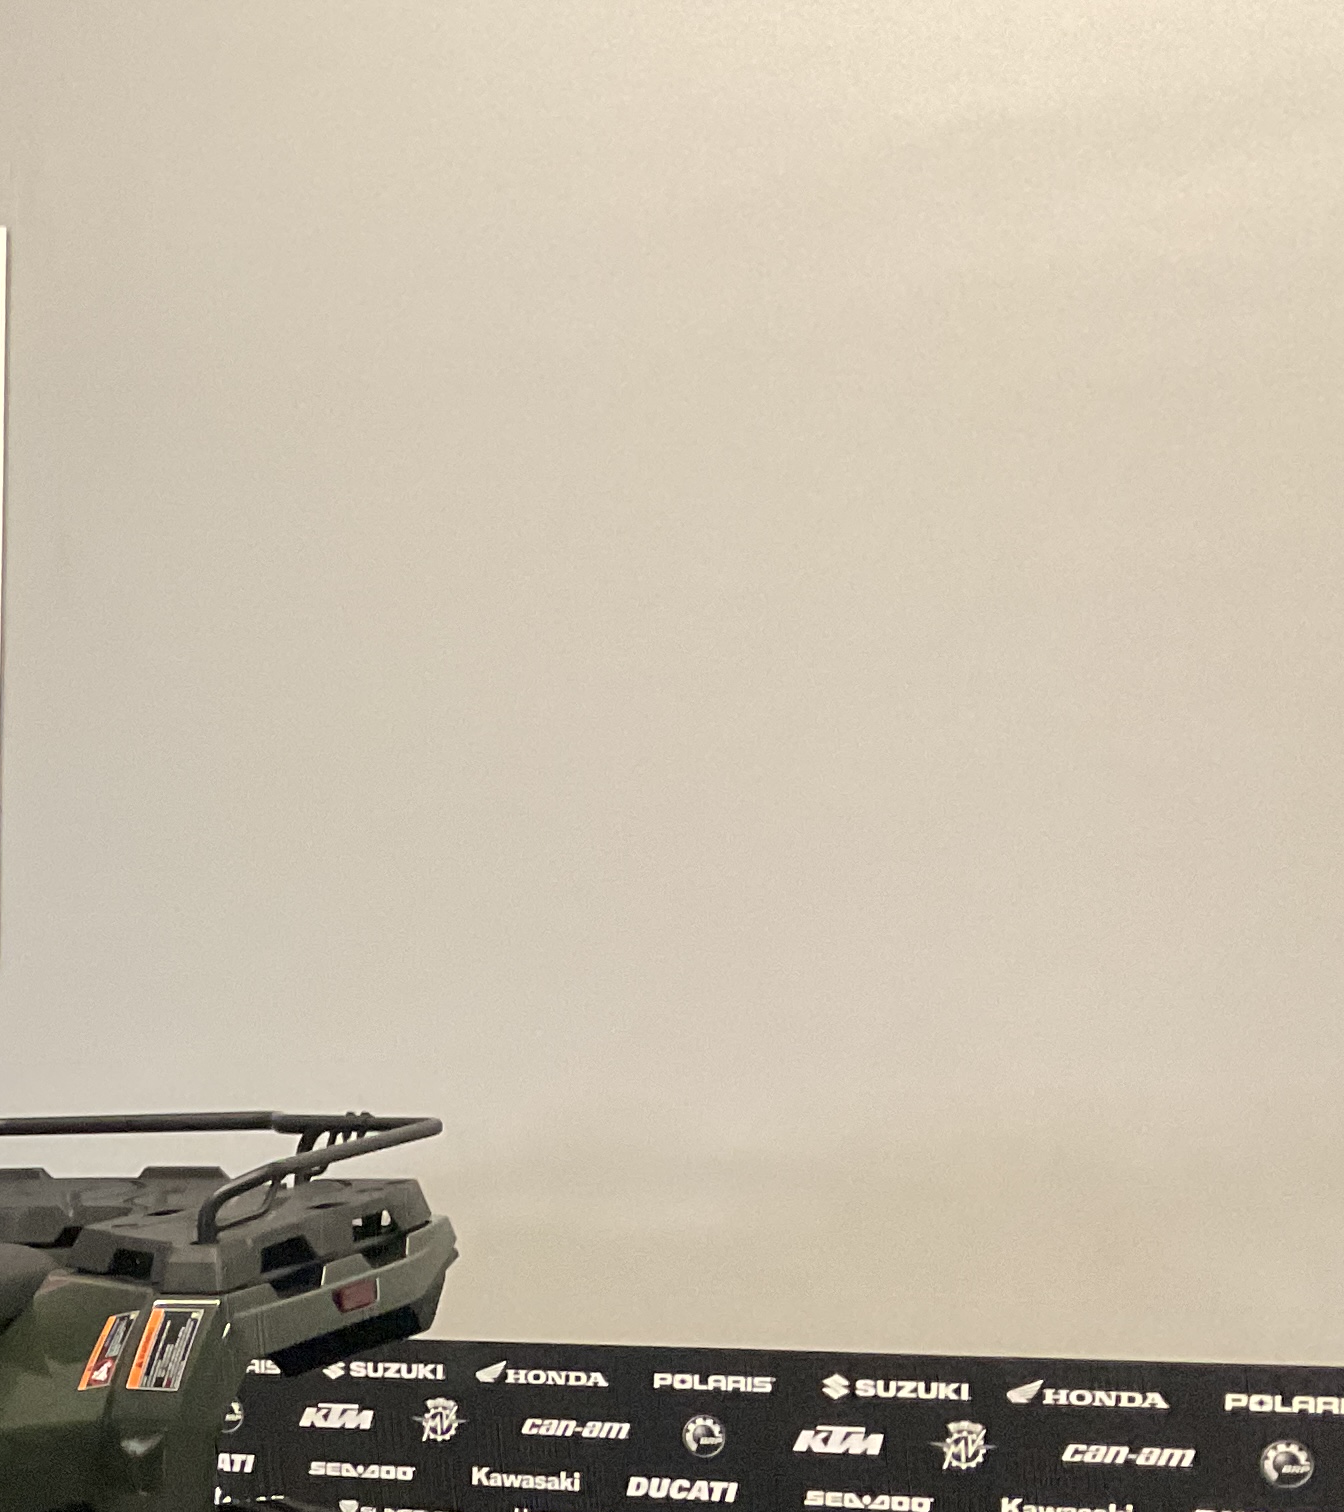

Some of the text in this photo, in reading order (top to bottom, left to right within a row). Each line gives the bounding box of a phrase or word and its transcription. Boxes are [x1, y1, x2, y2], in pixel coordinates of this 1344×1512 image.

[350, 1361, 445, 1380] SUZUKI
[507, 1370, 608, 1386] HONDA
[653, 1373, 776, 1393] POLARIS
[855, 1379, 971, 1401] SUZUKI
[1045, 1389, 1169, 1408] HONDA
[299, 1403, 374, 1429] KTM
[521, 1418, 630, 1439] can-am
[793, 1425, 884, 1455] KTM
[1062, 1444, 1196, 1467] can-am
[472, 1466, 580, 1491] Kawasaki
[626, 1477, 738, 1503] DUCATI
